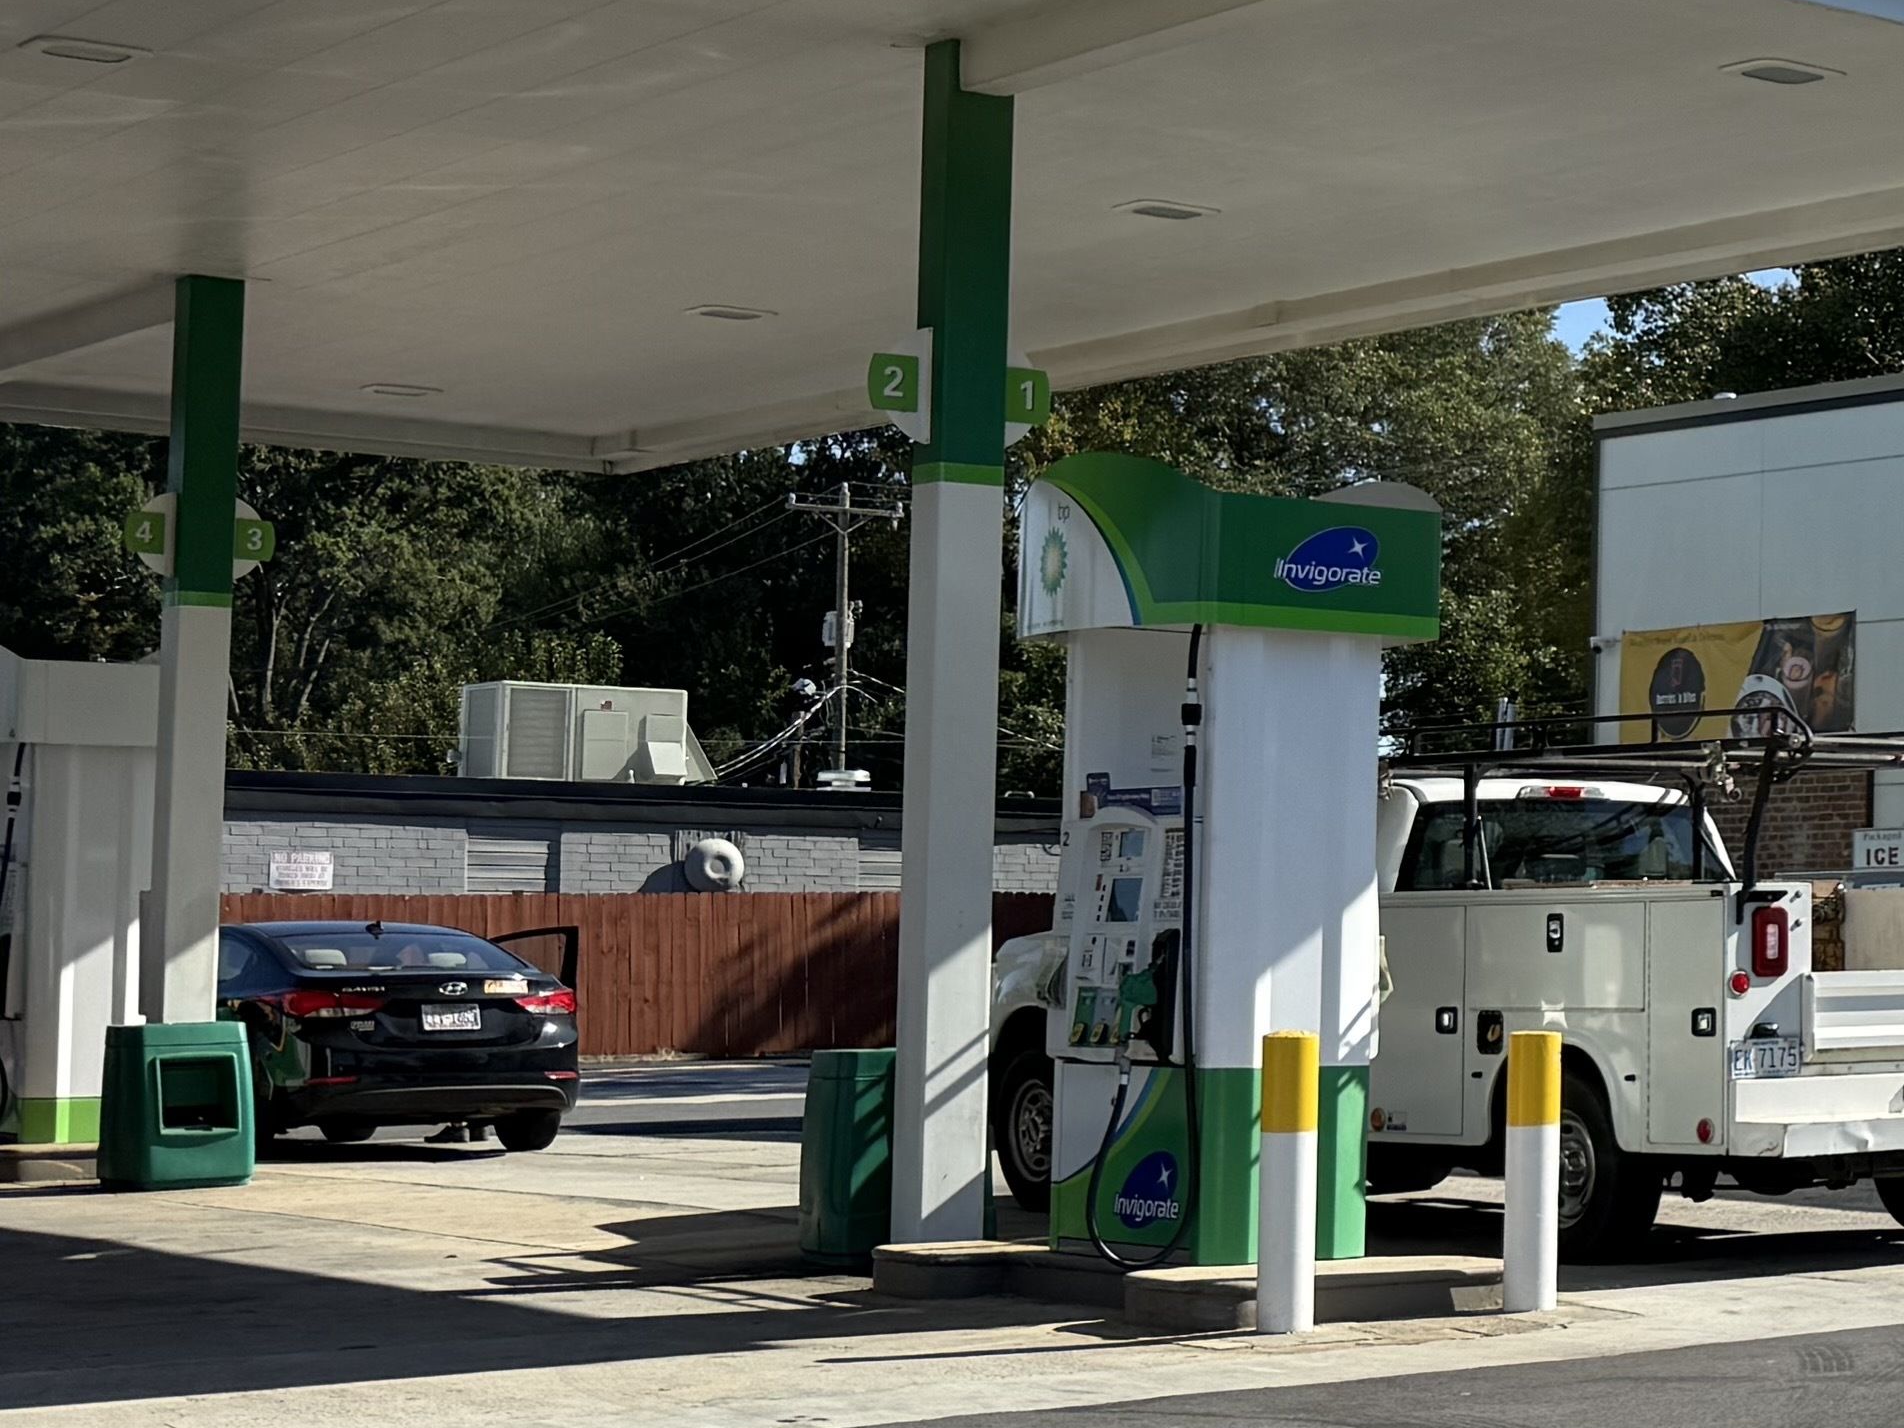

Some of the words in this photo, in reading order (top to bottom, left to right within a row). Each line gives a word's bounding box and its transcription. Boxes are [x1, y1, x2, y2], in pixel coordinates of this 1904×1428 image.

[883, 365, 905, 398] 2
[1020, 380, 1034, 411] 1
[135, 520, 153, 543] 4
[246, 527, 263, 550] 3
[1273, 557, 1382, 586] Invigorate
[1062, 831, 1070, 847] 2
[1862, 831, 1902, 842] Packaged
[1865, 846, 1899, 866] ICE
[1758, 1046, 1798, 1069] 7175
[1113, 1193, 1180, 1222] Invigorate
